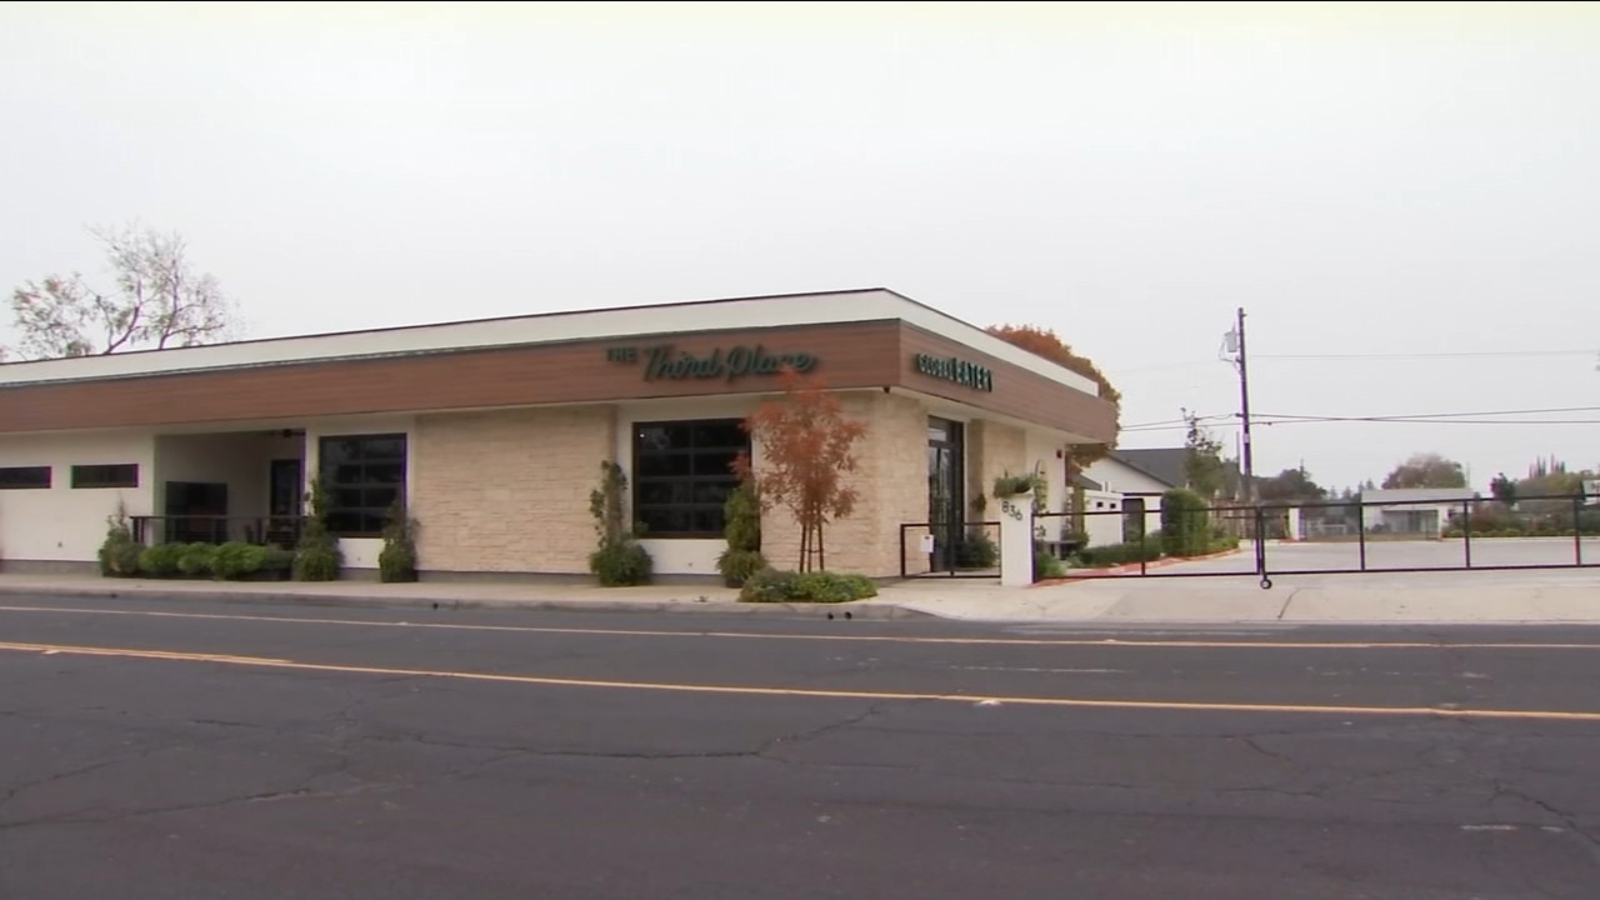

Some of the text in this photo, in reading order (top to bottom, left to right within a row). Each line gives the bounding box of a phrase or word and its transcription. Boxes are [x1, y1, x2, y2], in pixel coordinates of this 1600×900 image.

[606, 347, 639, 363] THE
[644, 344, 722, 382] Third
[1001, 500, 1023, 521] 836
